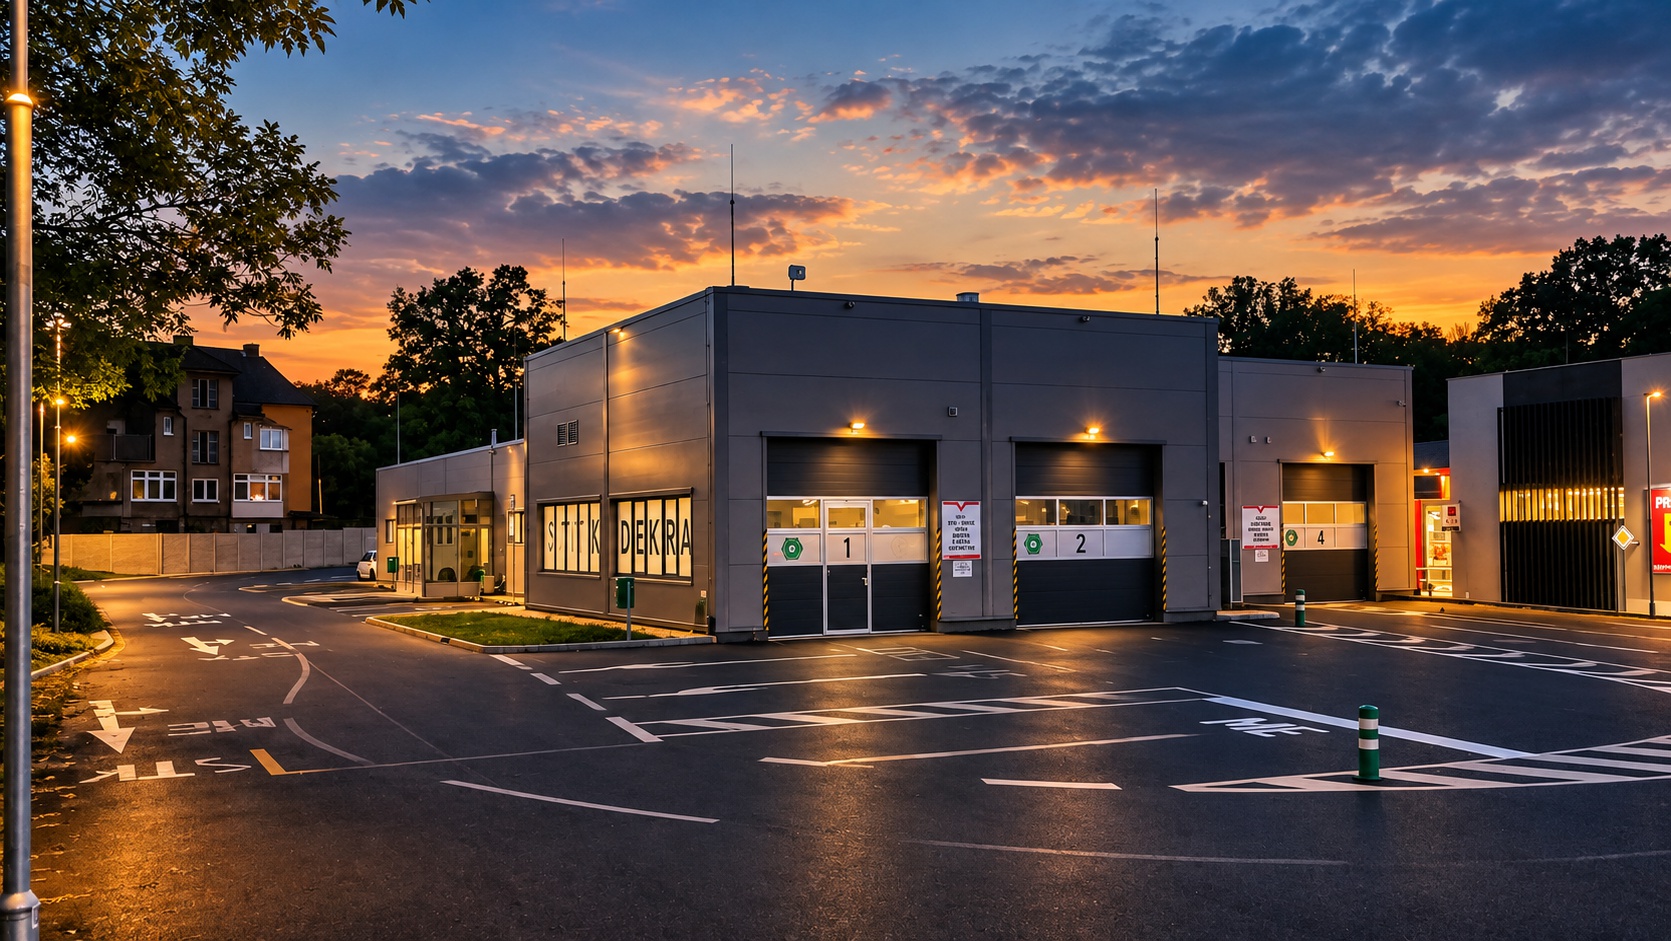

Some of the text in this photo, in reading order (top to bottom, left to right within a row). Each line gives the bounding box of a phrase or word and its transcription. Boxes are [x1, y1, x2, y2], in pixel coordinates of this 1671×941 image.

[621, 518, 692, 556] DEKRA
[1075, 533, 1087, 554] 2
[1317, 530, 1325, 545] 4
[843, 537, 851, 559] 1
